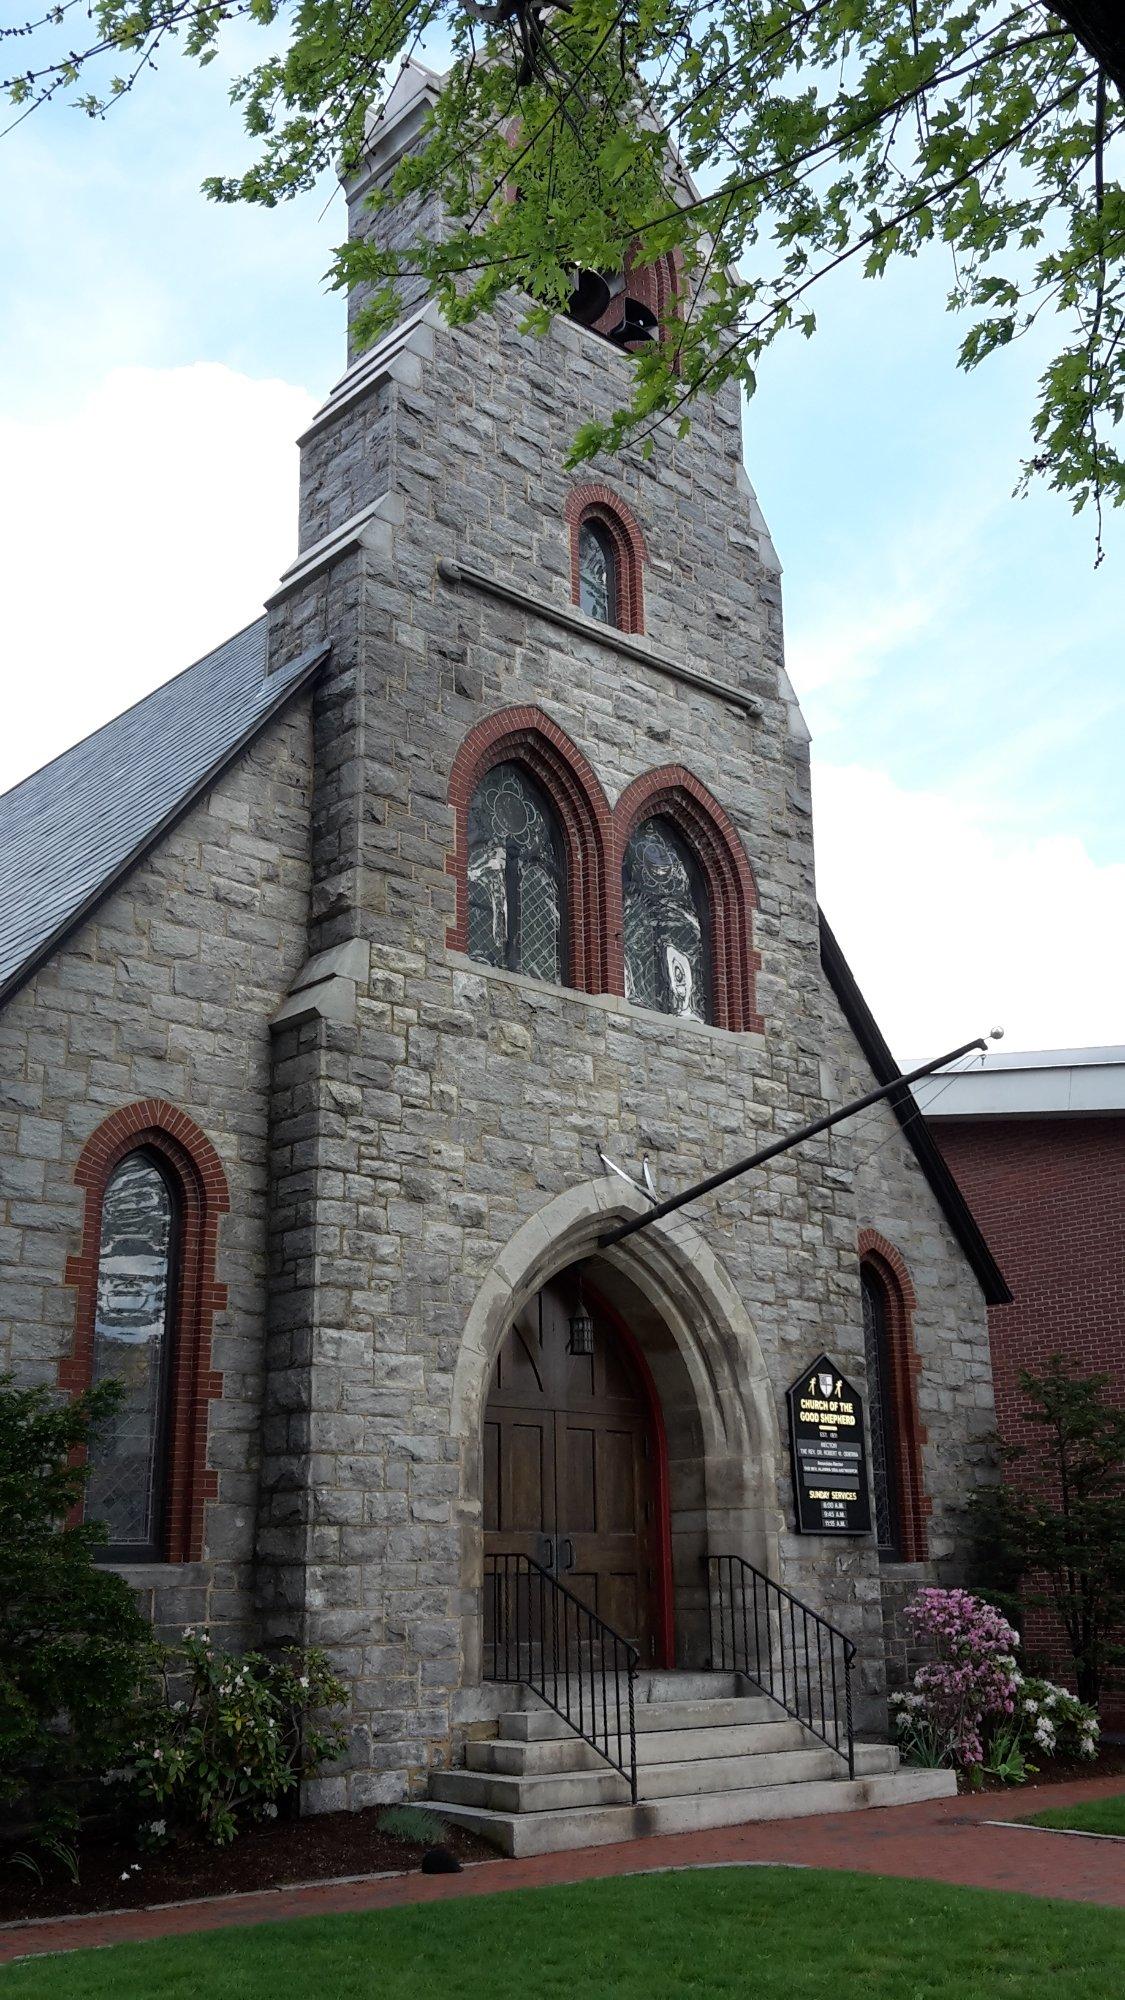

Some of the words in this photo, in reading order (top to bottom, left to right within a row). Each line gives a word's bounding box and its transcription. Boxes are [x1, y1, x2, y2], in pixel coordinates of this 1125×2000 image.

[801, 1398, 828, 1410] CHURCH
[829, 1401, 838, 1411] OF
[839, 1402, 853, 1413] THE
[800, 1411, 819, 1422] GOOD
[820, 1413, 855, 1425] SHEPHERD
[809, 1490, 829, 1499] SUNDAY
[831, 1491, 857, 1500] SERVICES
